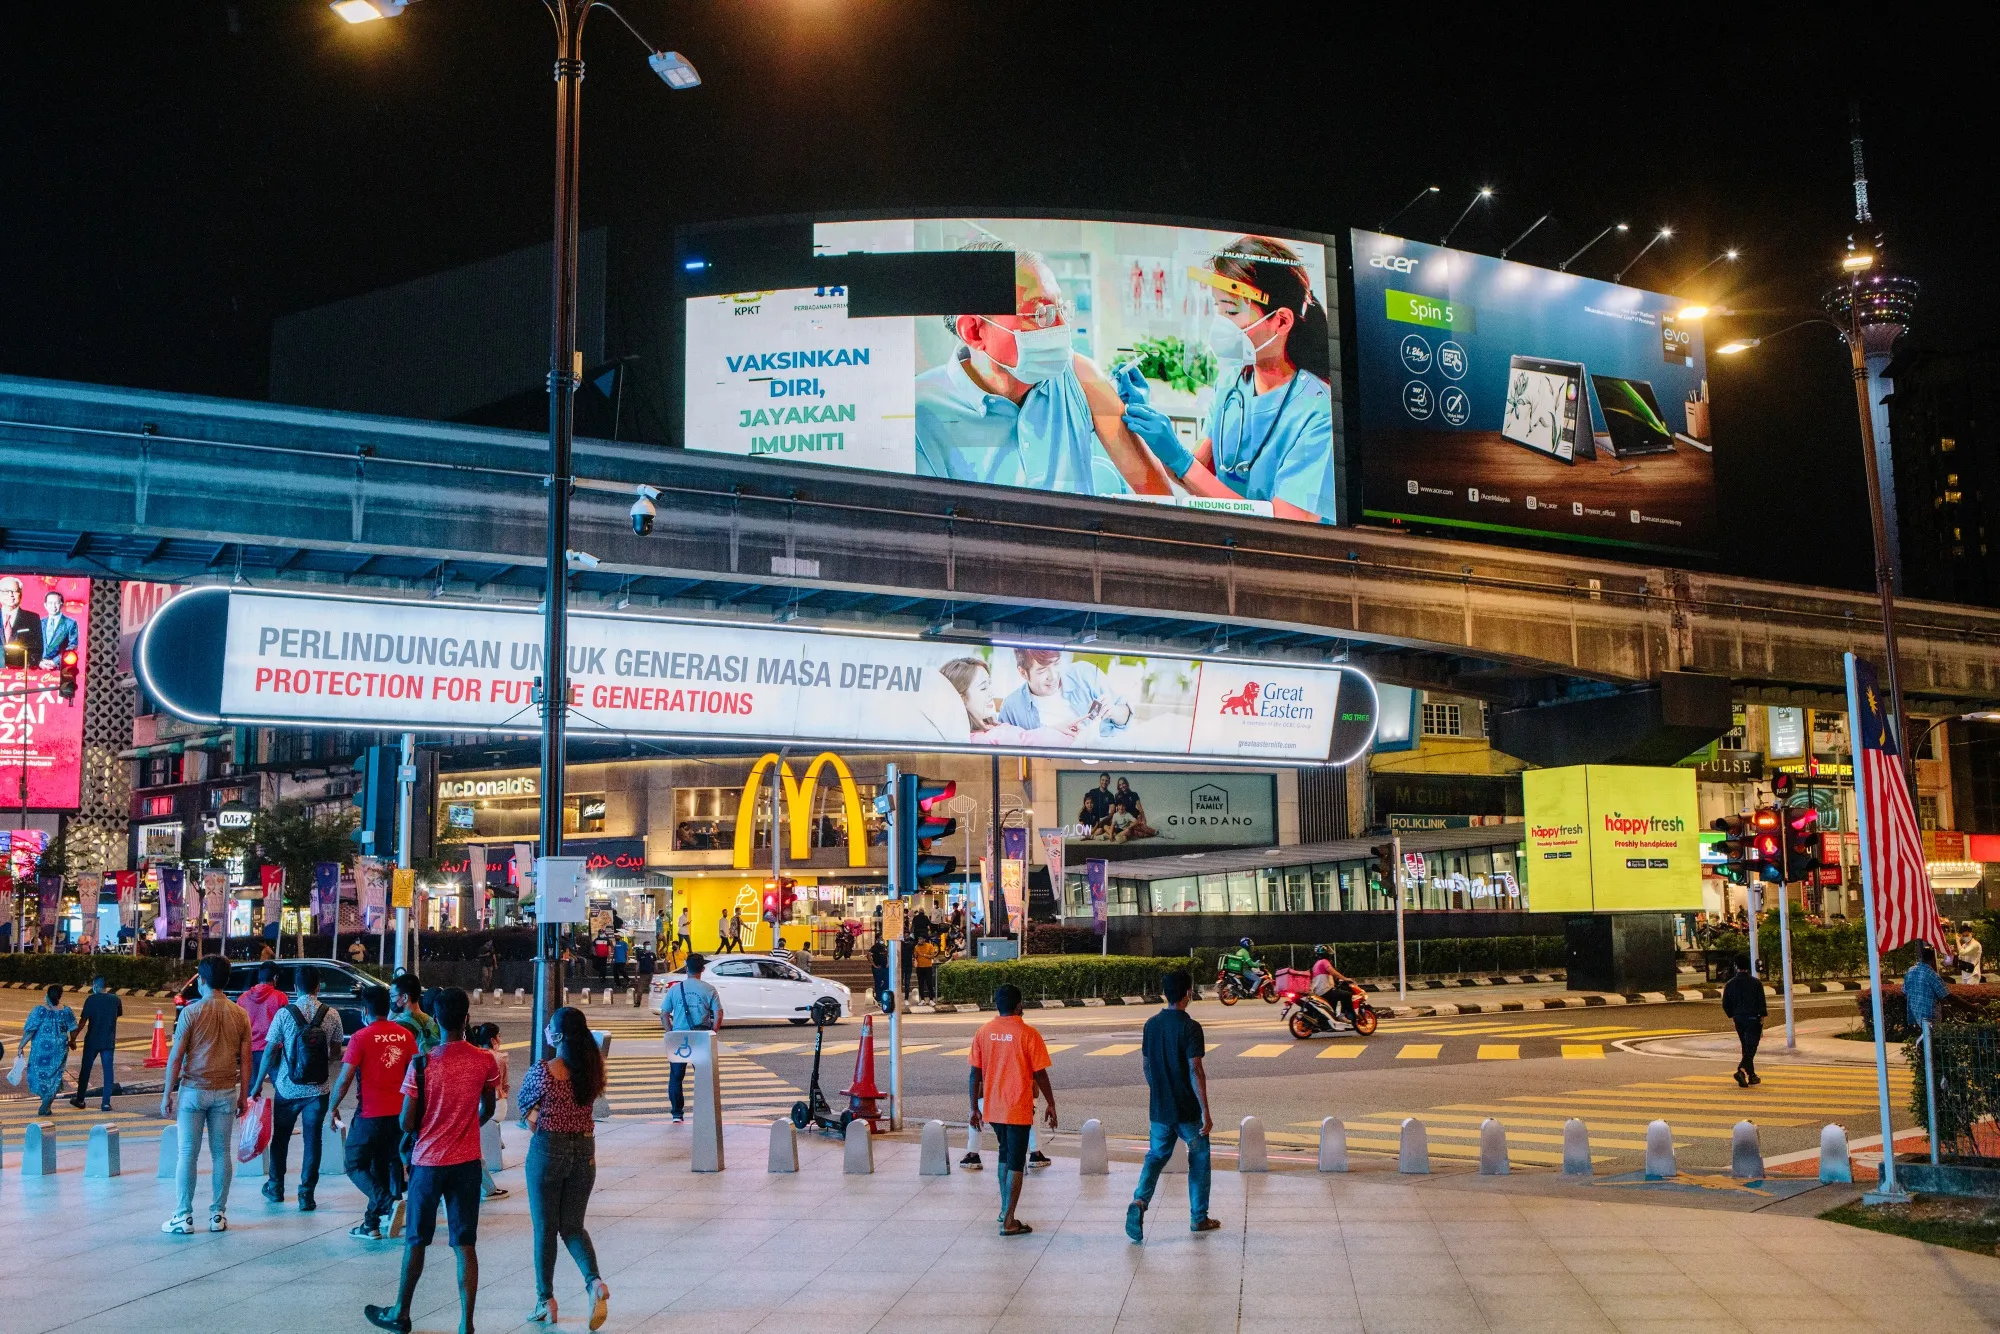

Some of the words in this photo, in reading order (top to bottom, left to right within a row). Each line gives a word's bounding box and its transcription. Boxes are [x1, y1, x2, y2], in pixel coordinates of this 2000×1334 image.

[1369, 252, 1418, 274] acer
[734, 305, 761, 316] KPKT
[1409, 300, 1441, 322] Spin
[1444, 305, 1453, 322] 5
[1664, 328, 1690, 344] evo
[725, 347, 870, 373] VAKSINKAN
[770, 377, 826, 399] DIRI,
[739, 404, 856, 429] JAYAKAN
[751, 431, 845, 454] IMUNITI
[1420, 486, 1454, 496] www.acer.com
[1189, 500, 1232, 510] LINDUNG
[1233, 502, 1255, 512] DIRI,
[258, 626, 502, 671] PERLINDUNGAN
[510, 641, 607, 675] UNUK
[614, 648, 748, 683] GENERASI
[756, 656, 832, 688] MASA
[840, 660, 922, 694] DEPAN
[255, 666, 425, 699] PROTECTION
[431, 675, 484, 703] FOR
[490, 679, 585, 707] FUTE
[592, 684, 754, 716] GENERATIONS
[1263, 682, 1304, 702] Great
[1261, 701, 1313, 719] Eastern
[1342, 713, 1353, 721] BIG
[1238, 740, 1297, 750] greateasternlife.com
[1817, 763, 1853, 776] EMPRE
[439, 777, 536, 799] McDonald's
[1196, 802, 1223, 811] FAMILY
[1167, 815, 1253, 827] GIORDANO
[1391, 818, 1447, 829] POLIKLINIK
[1605, 812, 1685, 835] happyfresh
[1531, 823, 1583, 839] happyfresh
[1615, 840, 1639, 849] Freshly
[1639, 840, 1678, 849] handpicked
[375, 1033, 408, 1043] PXCM
[990, 1033, 1013, 1042] CLUB
